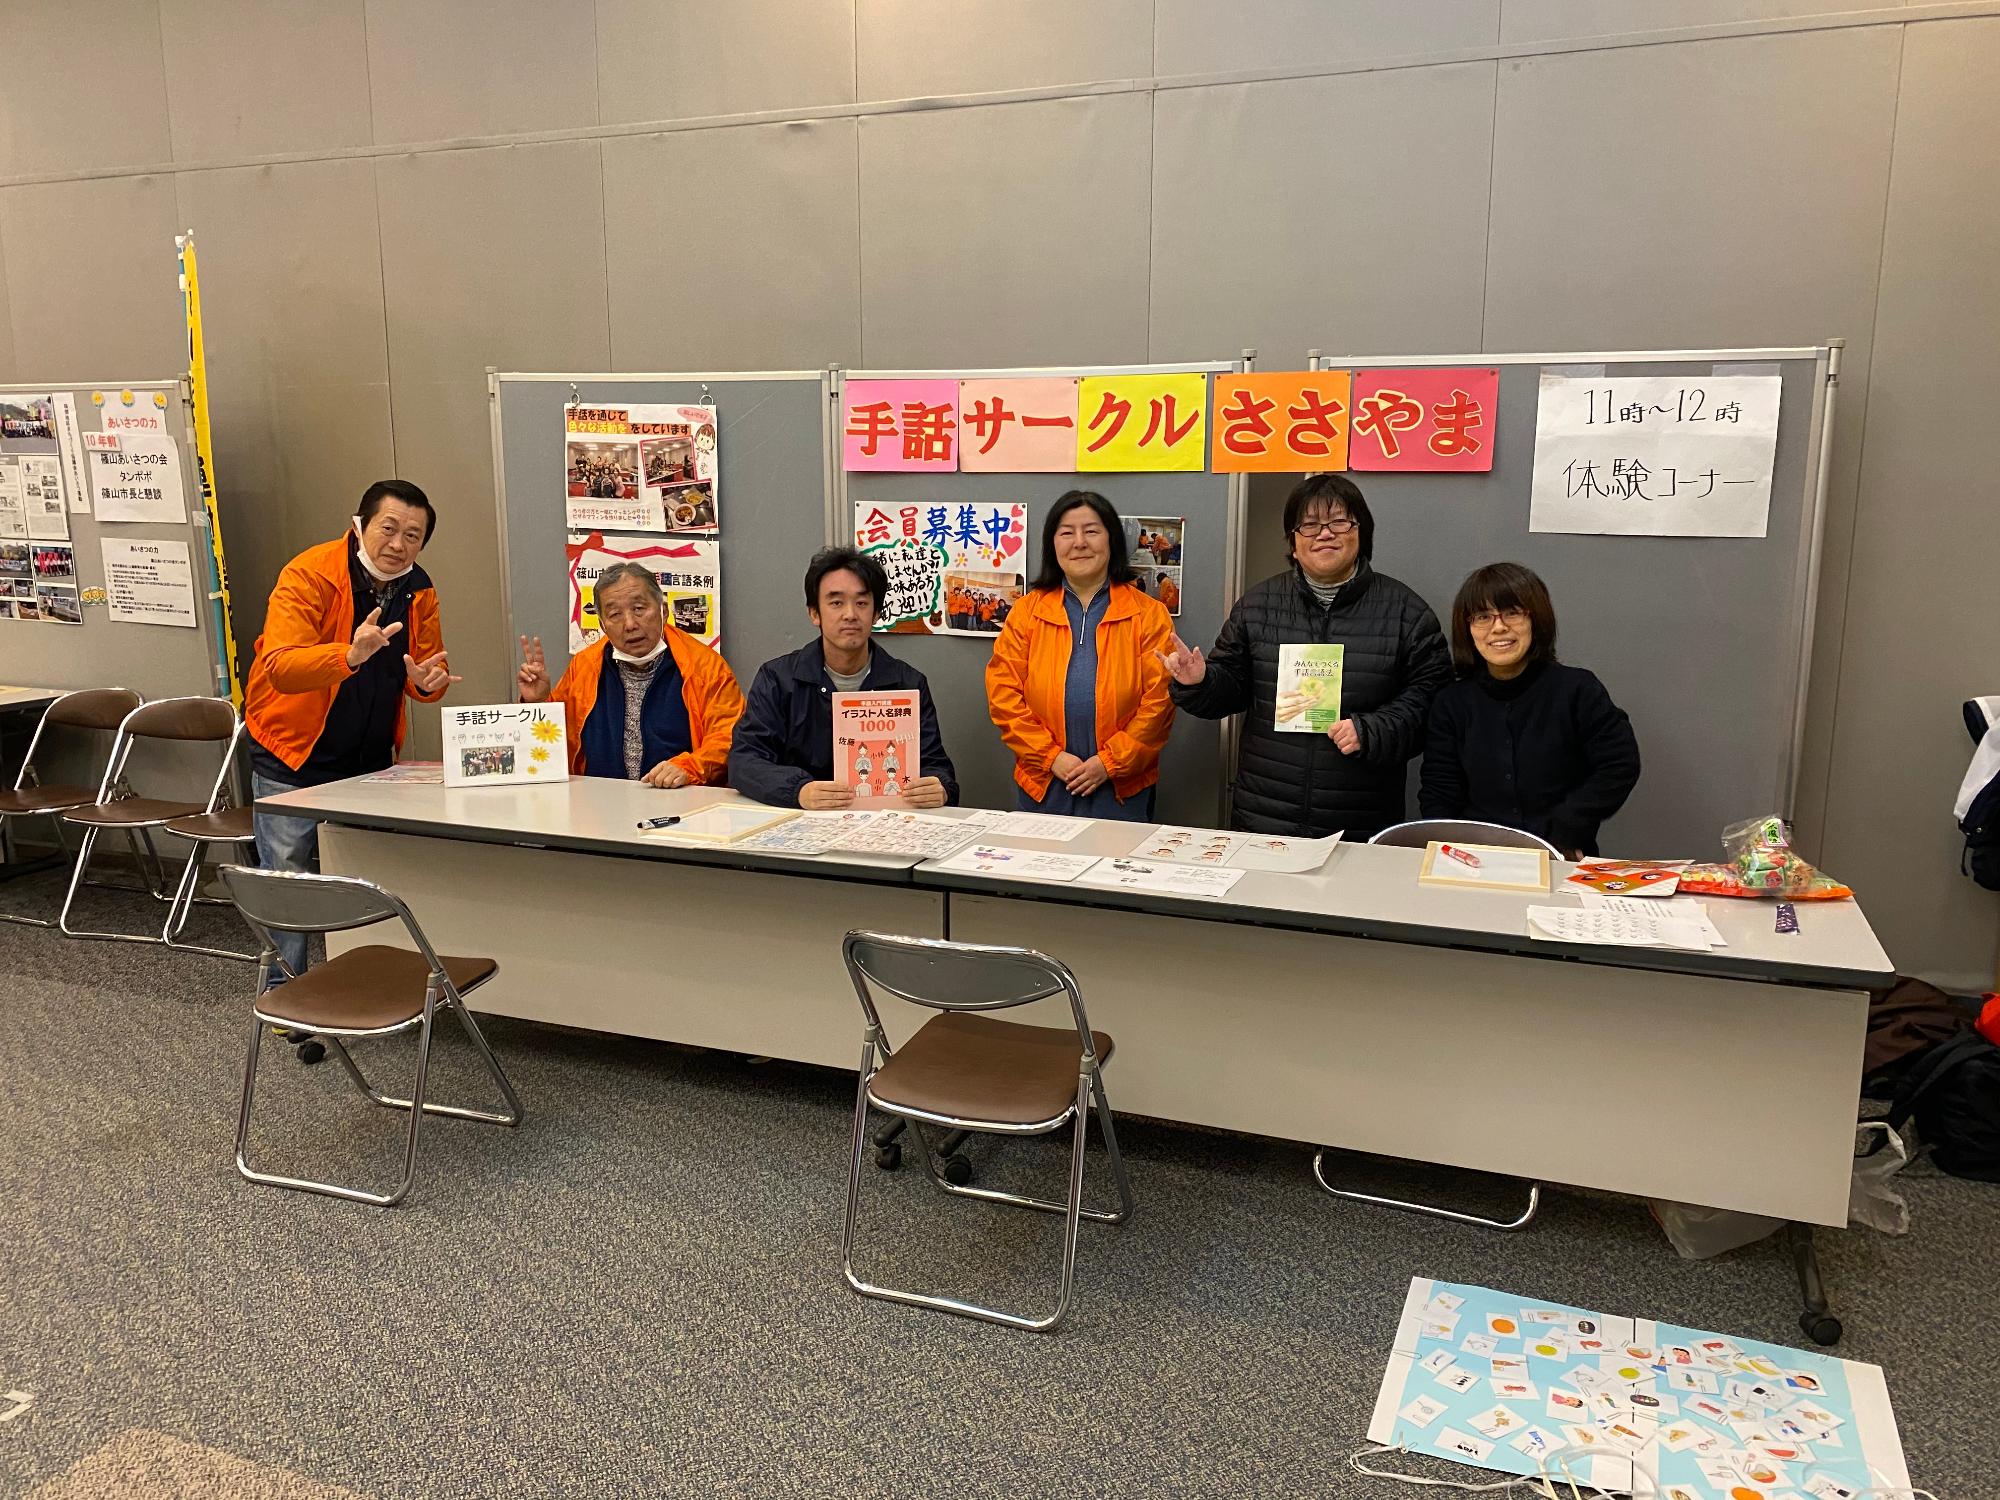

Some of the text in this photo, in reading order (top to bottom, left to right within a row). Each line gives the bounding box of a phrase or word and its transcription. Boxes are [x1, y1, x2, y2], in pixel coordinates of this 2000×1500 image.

[568, 409, 627, 421] 手話を通じて
[108, 416, 158, 429] あいさつの力
[631, 424, 690, 435] をしています
[101, 453, 168, 466] 篠山あいさつの会
[120, 471, 152, 482] タンポポ
[1563, 459, 1755, 500] 体験コーナー
[101, 488, 163, 500] 篠山市長と懇談
[865, 503, 1010, 550] 会員募集中
[130, 545, 159, 554] あいさつの力
[456, 708, 546, 726] 手話サークル
[841, 707, 912, 719] イラスト人名辞典
[859, 720, 896, 732] 1000
